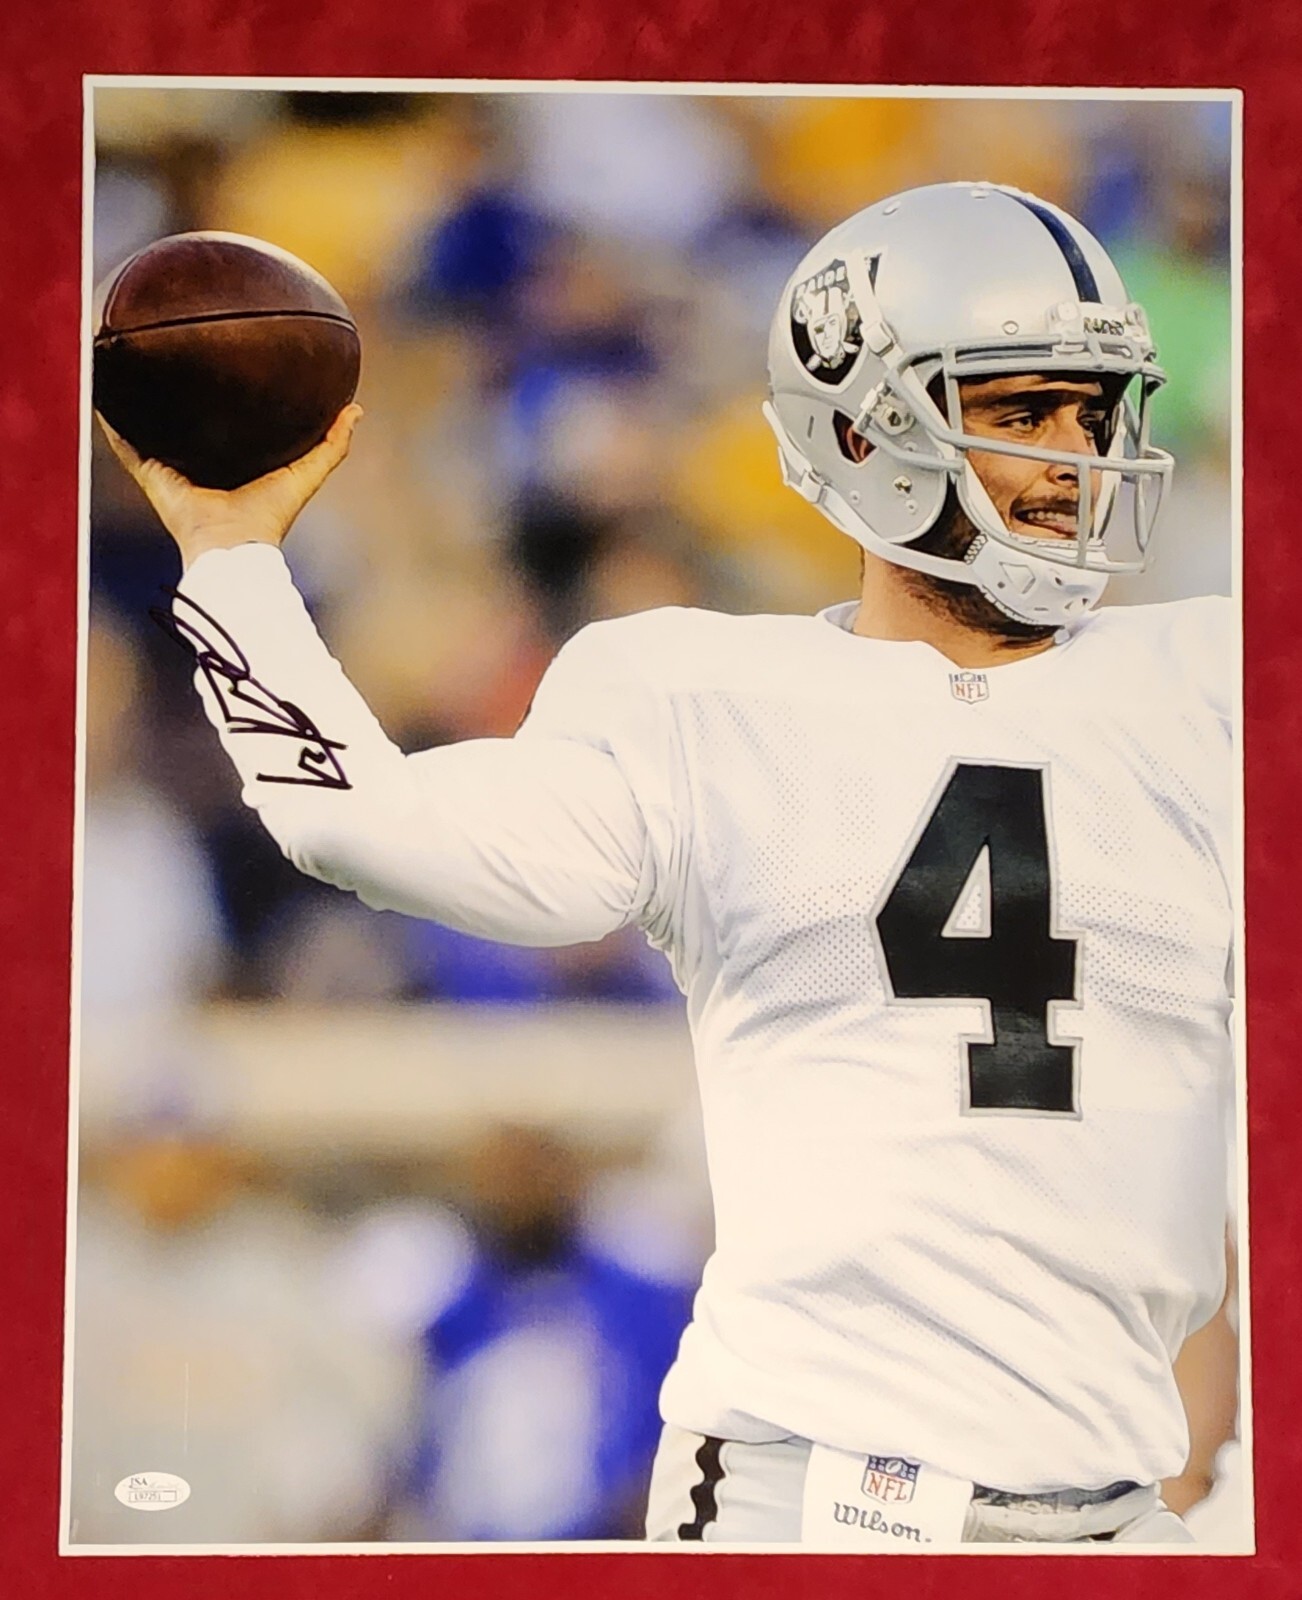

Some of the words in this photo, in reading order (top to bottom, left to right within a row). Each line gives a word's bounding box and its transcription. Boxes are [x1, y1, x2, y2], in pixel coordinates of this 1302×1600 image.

[955, 683, 986, 699] NFL
[867, 756, 1085, 1120] 4
[866, 1472, 907, 1501] NFL
